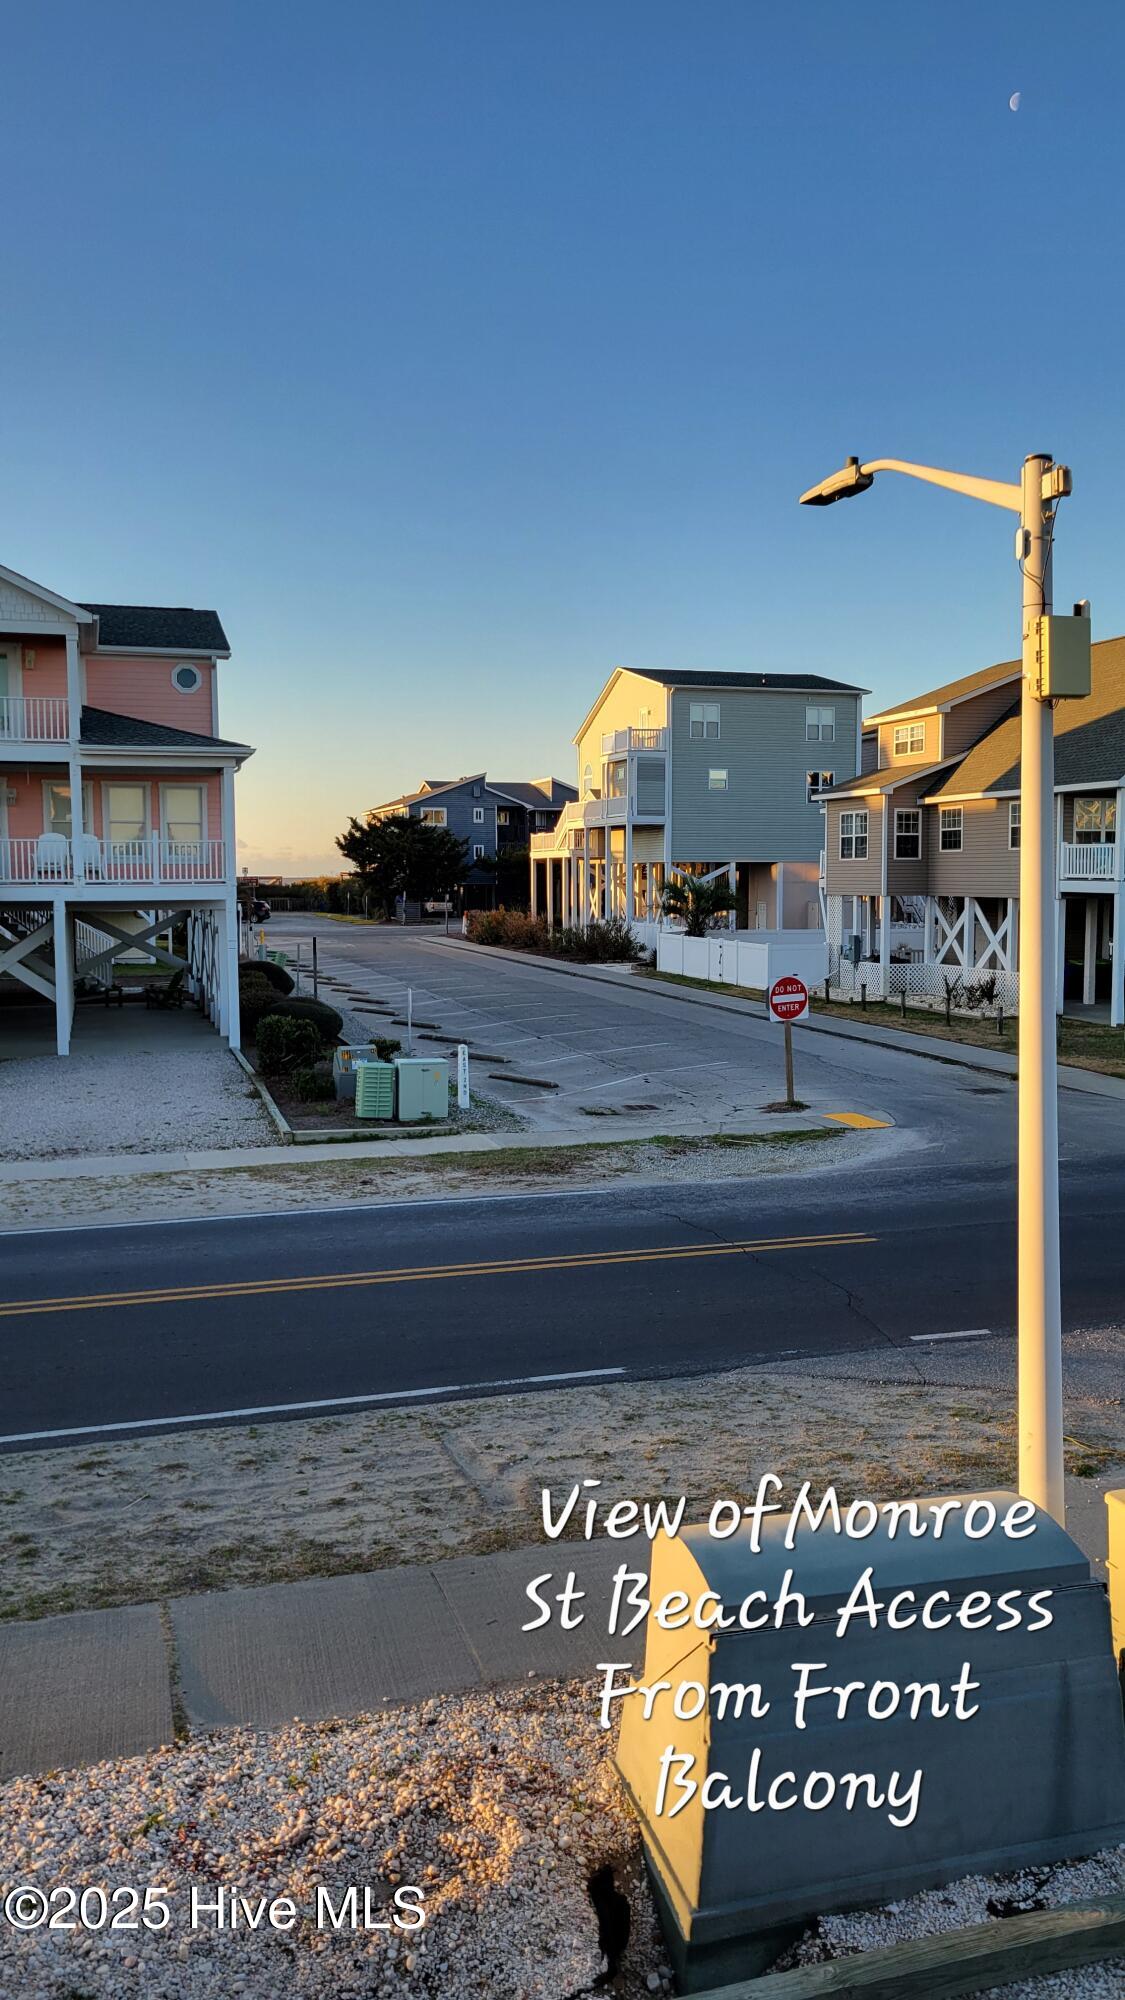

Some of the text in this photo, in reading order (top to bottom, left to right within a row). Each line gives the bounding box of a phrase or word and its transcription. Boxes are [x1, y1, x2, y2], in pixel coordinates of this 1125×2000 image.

[775, 984, 801, 994] DO NOT
[778, 1004, 799, 1012] ENTER
